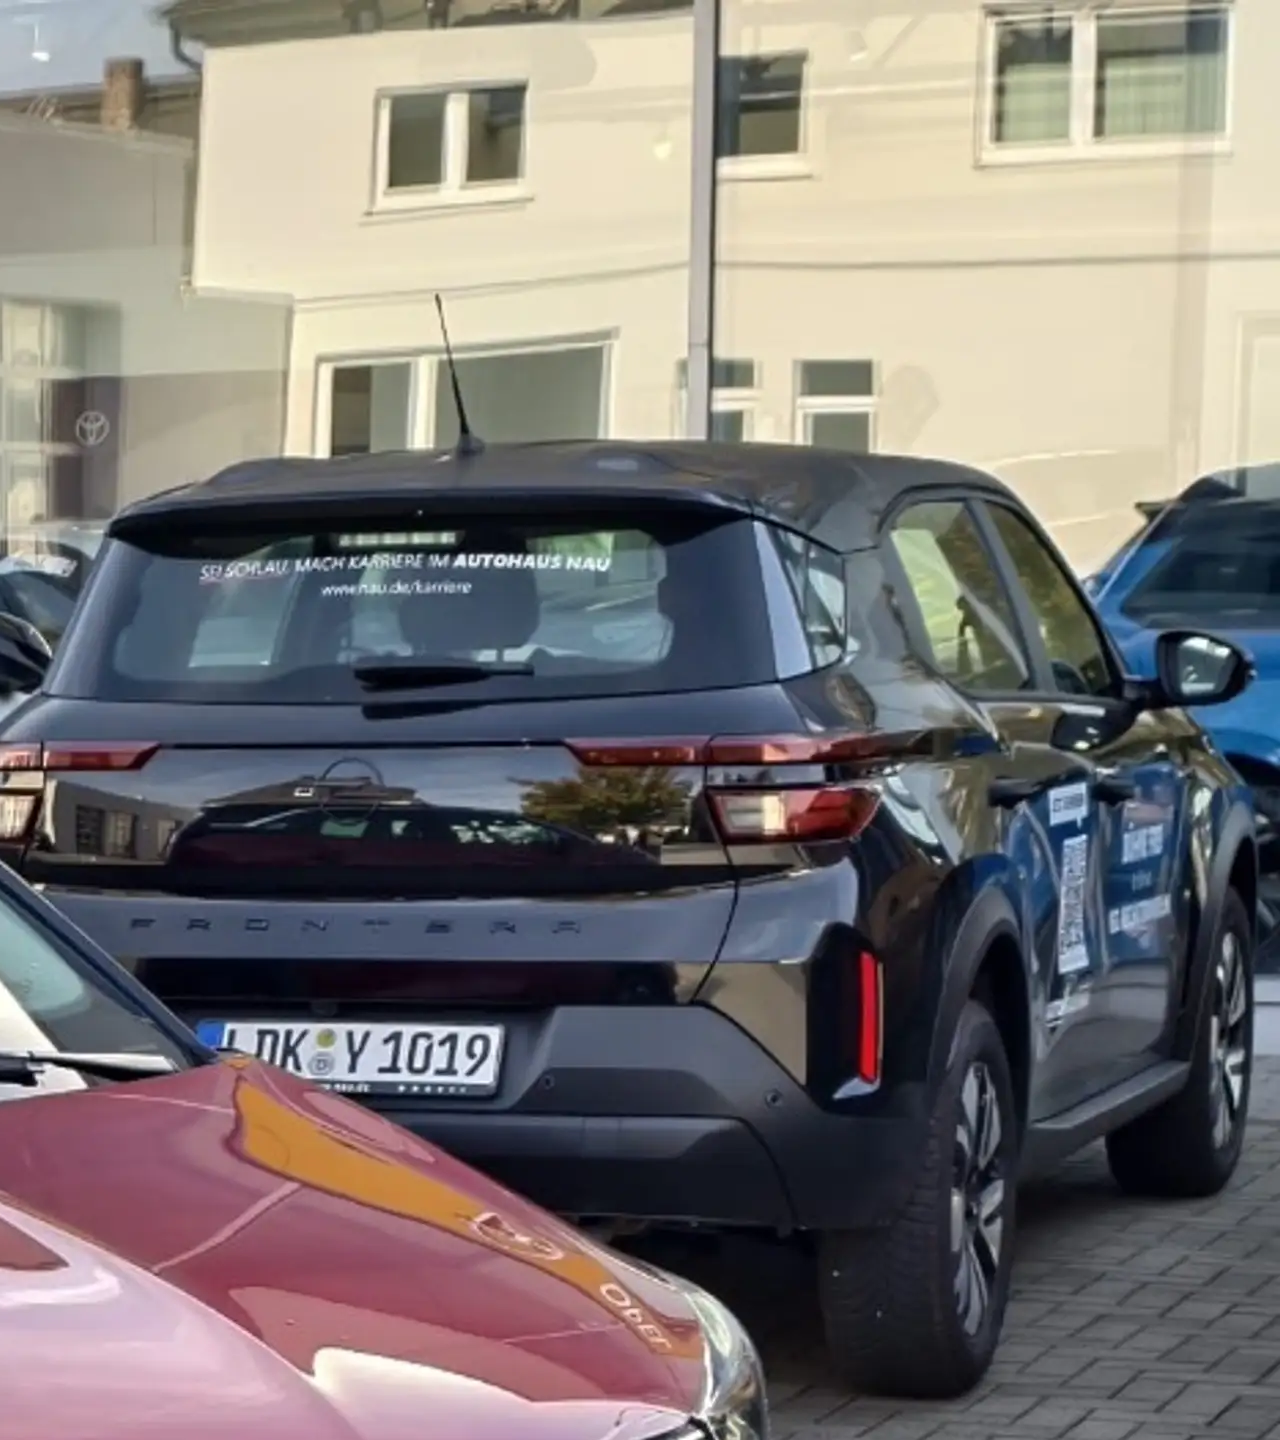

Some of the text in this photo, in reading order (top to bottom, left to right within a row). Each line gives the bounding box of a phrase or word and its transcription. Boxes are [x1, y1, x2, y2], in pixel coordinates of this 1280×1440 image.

[294, 555, 344, 573] MACH
[347, 552, 423, 570] KARRIERE
[452, 553, 561, 570] AUTOHAUS
[565, 555, 612, 572] NAU
[320, 580, 473, 597] www.nau.de/karriere
[345, 1029, 371, 1074] Y
[378, 1030, 492, 1077] 1019
